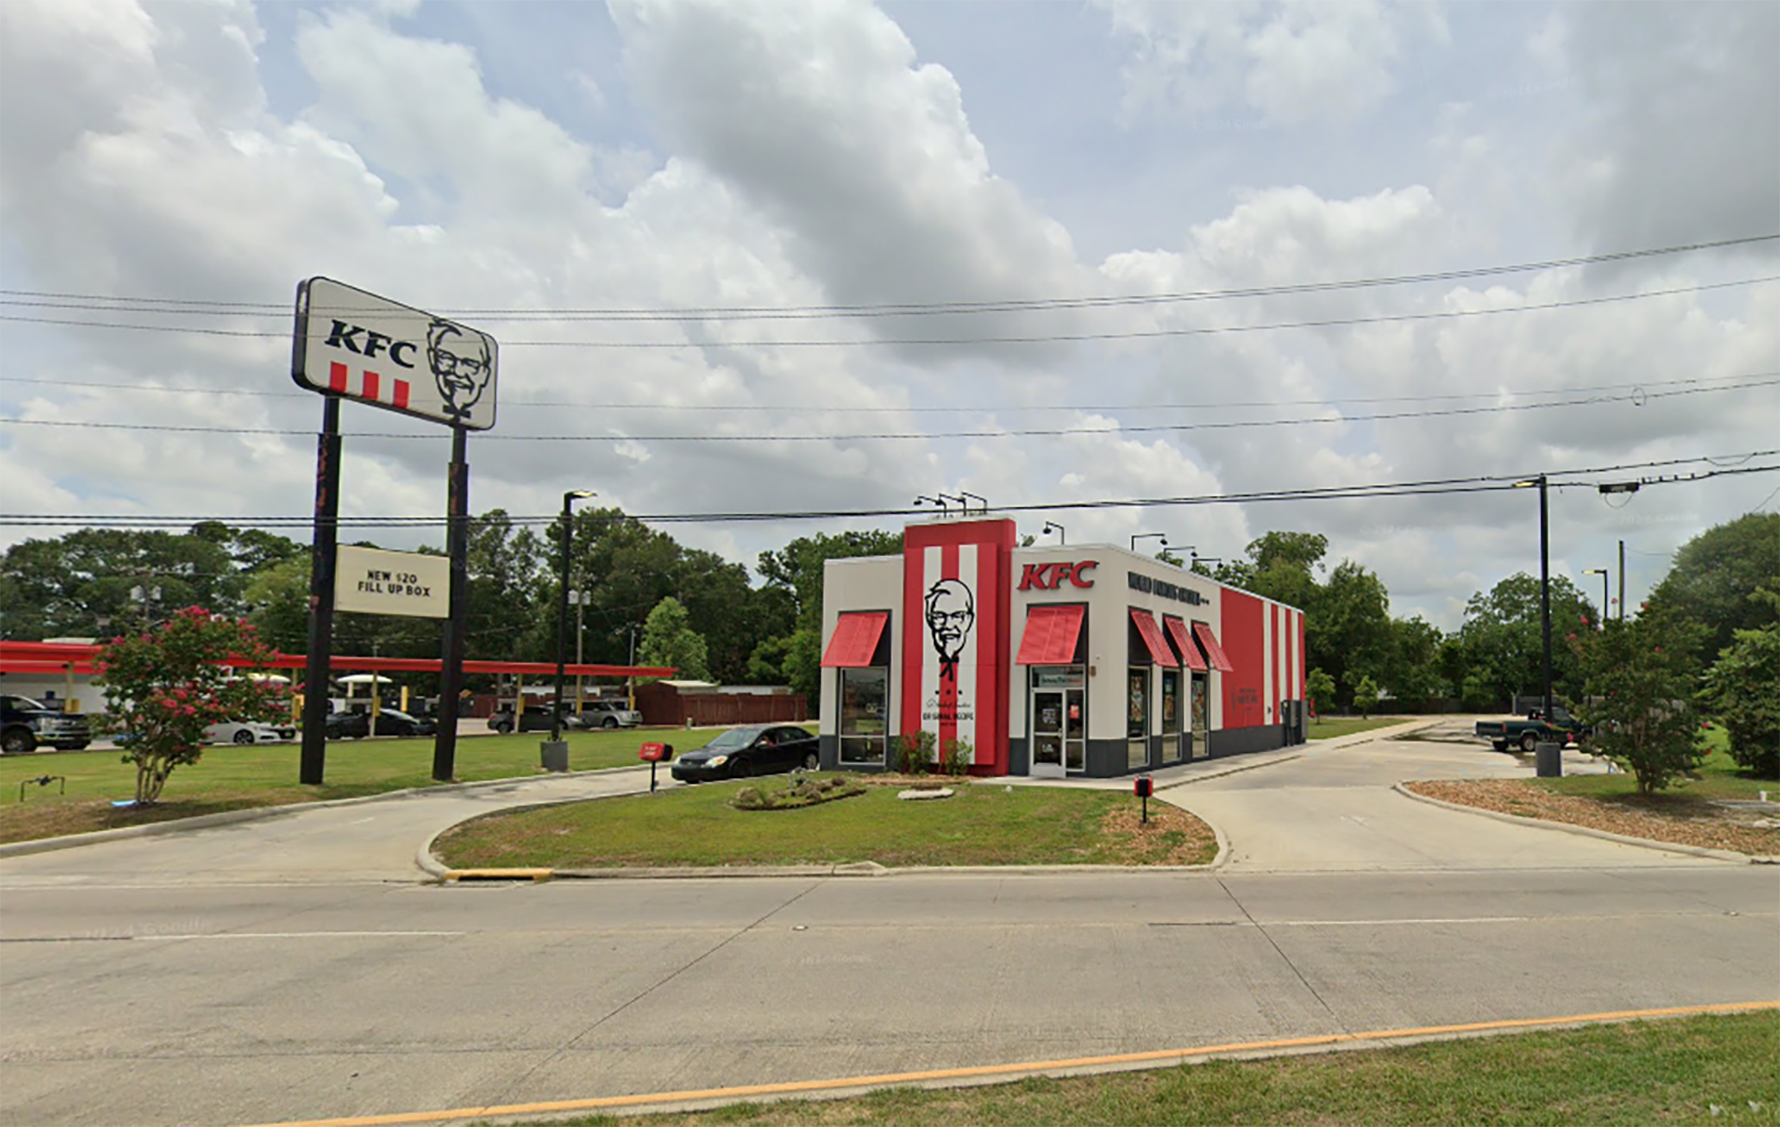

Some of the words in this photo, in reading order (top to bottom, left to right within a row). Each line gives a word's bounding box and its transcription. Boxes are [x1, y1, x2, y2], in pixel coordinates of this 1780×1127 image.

[324, 319, 418, 369] KFC
[367, 570, 391, 582] NEW
[1017, 560, 1100, 591] KFC
[358, 581, 383, 594] FILL
[388, 583, 403, 595] UP
[406, 585, 431, 597] BOX
